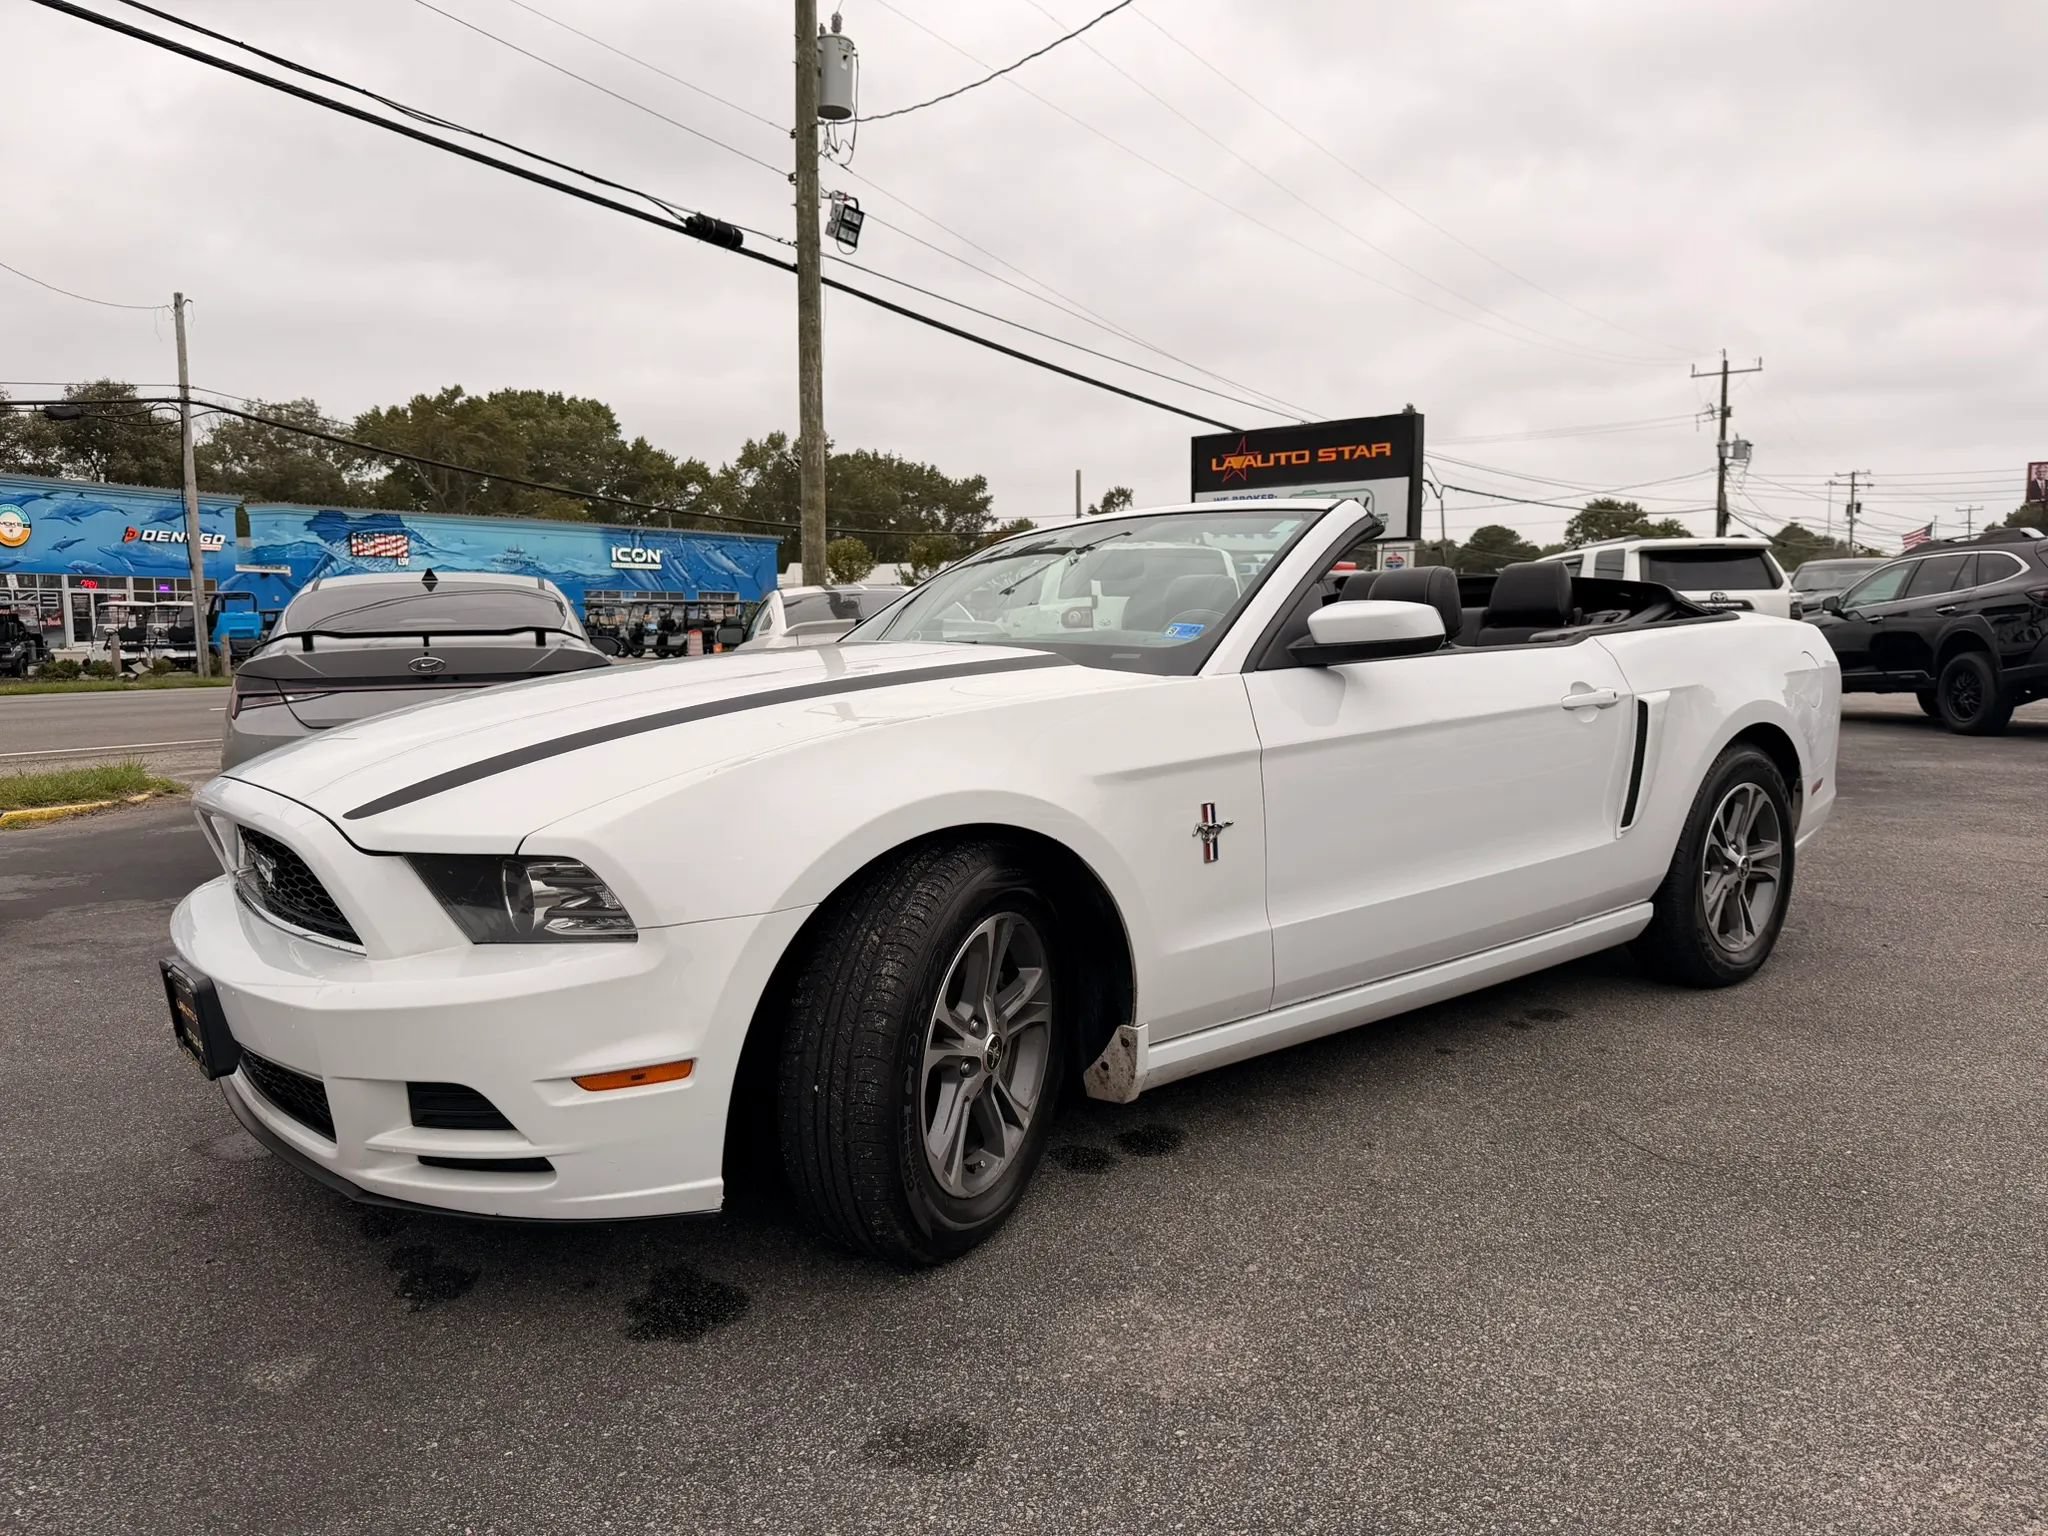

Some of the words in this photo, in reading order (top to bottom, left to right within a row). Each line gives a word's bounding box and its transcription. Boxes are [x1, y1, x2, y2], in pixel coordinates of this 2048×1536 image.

[1240, 449, 1310, 468] AUTO
[1317, 442, 1392, 462] STAR
[141, 529, 226, 545] DENGO
[611, 546, 661, 563] ICON
